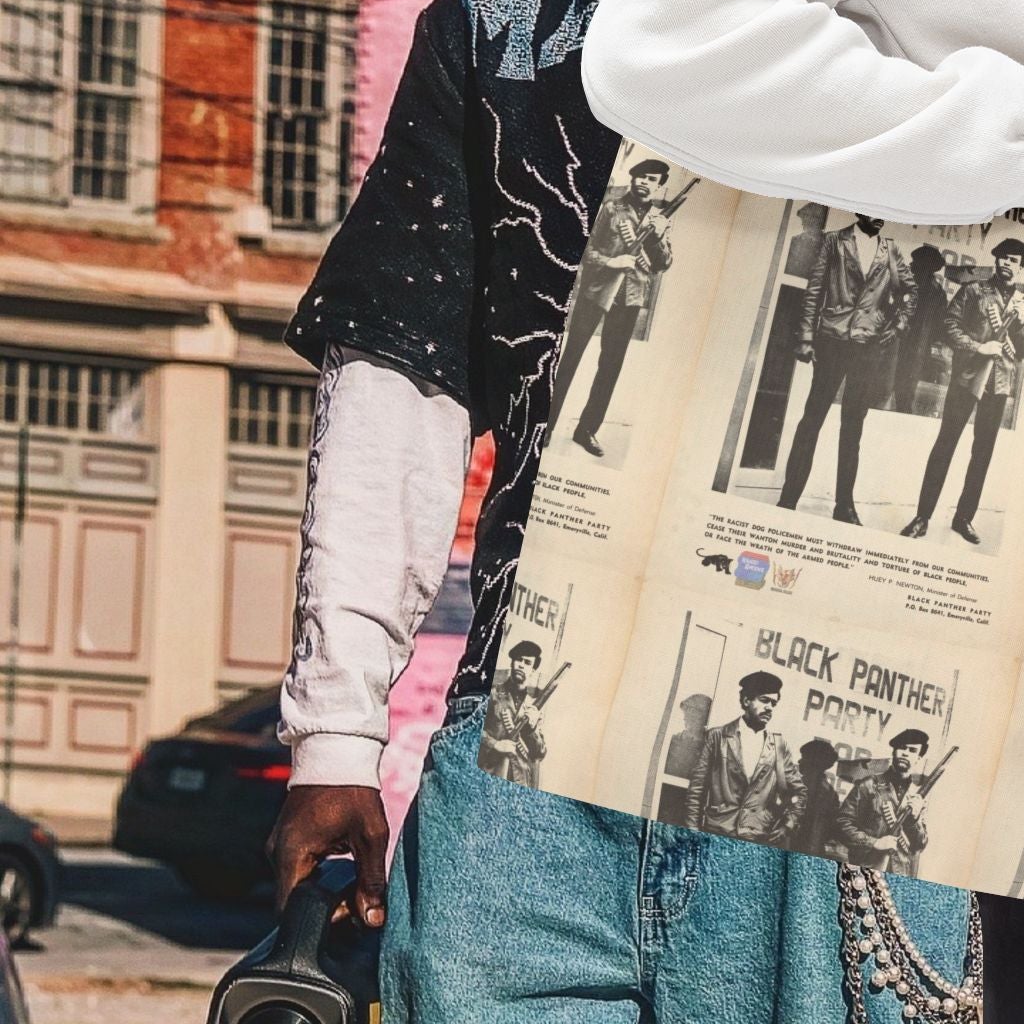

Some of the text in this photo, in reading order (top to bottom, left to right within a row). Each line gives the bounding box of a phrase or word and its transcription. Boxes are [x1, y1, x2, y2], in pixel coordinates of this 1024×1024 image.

[549, 475, 562, 483] OUR
[550, 511, 584, 525] PANTHER
[587, 521, 611, 532] PARTY
[706, 523, 726, 532] CEASE
[728, 528, 747, 538] THEIR
[750, 533, 779, 544] WANTON
[781, 540, 807, 551] MURDER
[826, 550, 862, 563] BRUTALITY
[863, 559, 879, 567] AND
[882, 562, 910, 574] TORTURE
[923, 572, 943, 581] BLACK
[716, 534, 732, 543] FACE
[735, 538, 747, 546] THE
[750, 542, 773, 552] WRATH
[787, 550, 800, 559] THE
[802, 554, 824, 564] ARMED
[727, 518, 750, 528] RACIST
[751, 524, 765, 532] DOG
[767, 528, 804, 541] POLICEMEN
[806, 536, 824, 545] MUST
[826, 541, 863, 554] WITHDRAW
[865, 550, 910, 564] IMMEDIATELY
[912, 560, 930, 569] FROM
[931, 564, 945, 572] OUR
[867, 575, 887, 583] HUEY
[907, 595, 992, 617] BLACK PANTHER PARTY
[754, 628, 946, 717] BLACK PANTHER
[803, 688, 892, 742] PARTY
